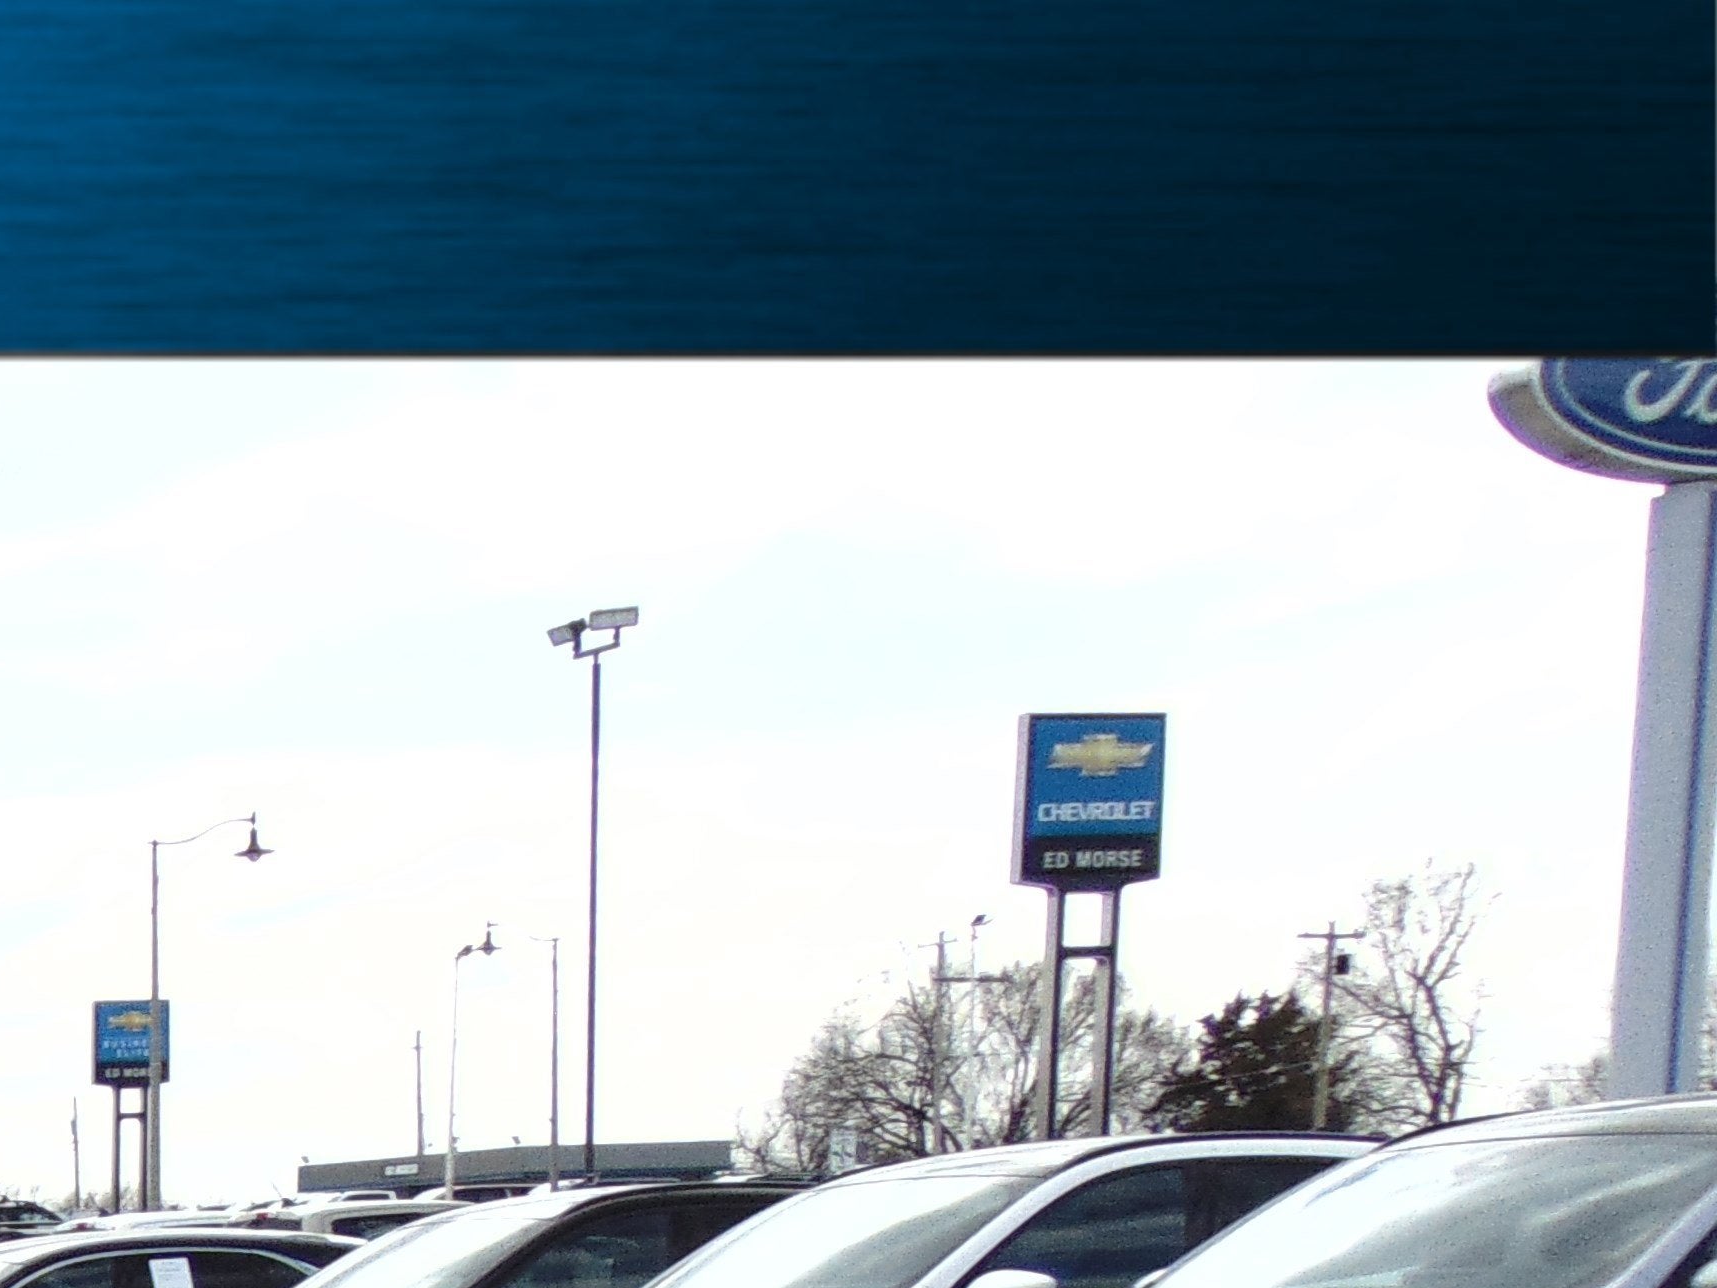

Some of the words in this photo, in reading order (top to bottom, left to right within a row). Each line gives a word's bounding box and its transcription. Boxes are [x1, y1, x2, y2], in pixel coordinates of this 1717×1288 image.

[1038, 801, 1155, 822] CHEVROLET
[1043, 851, 1070, 868] ED
[1076, 849, 1143, 868] MORSE
